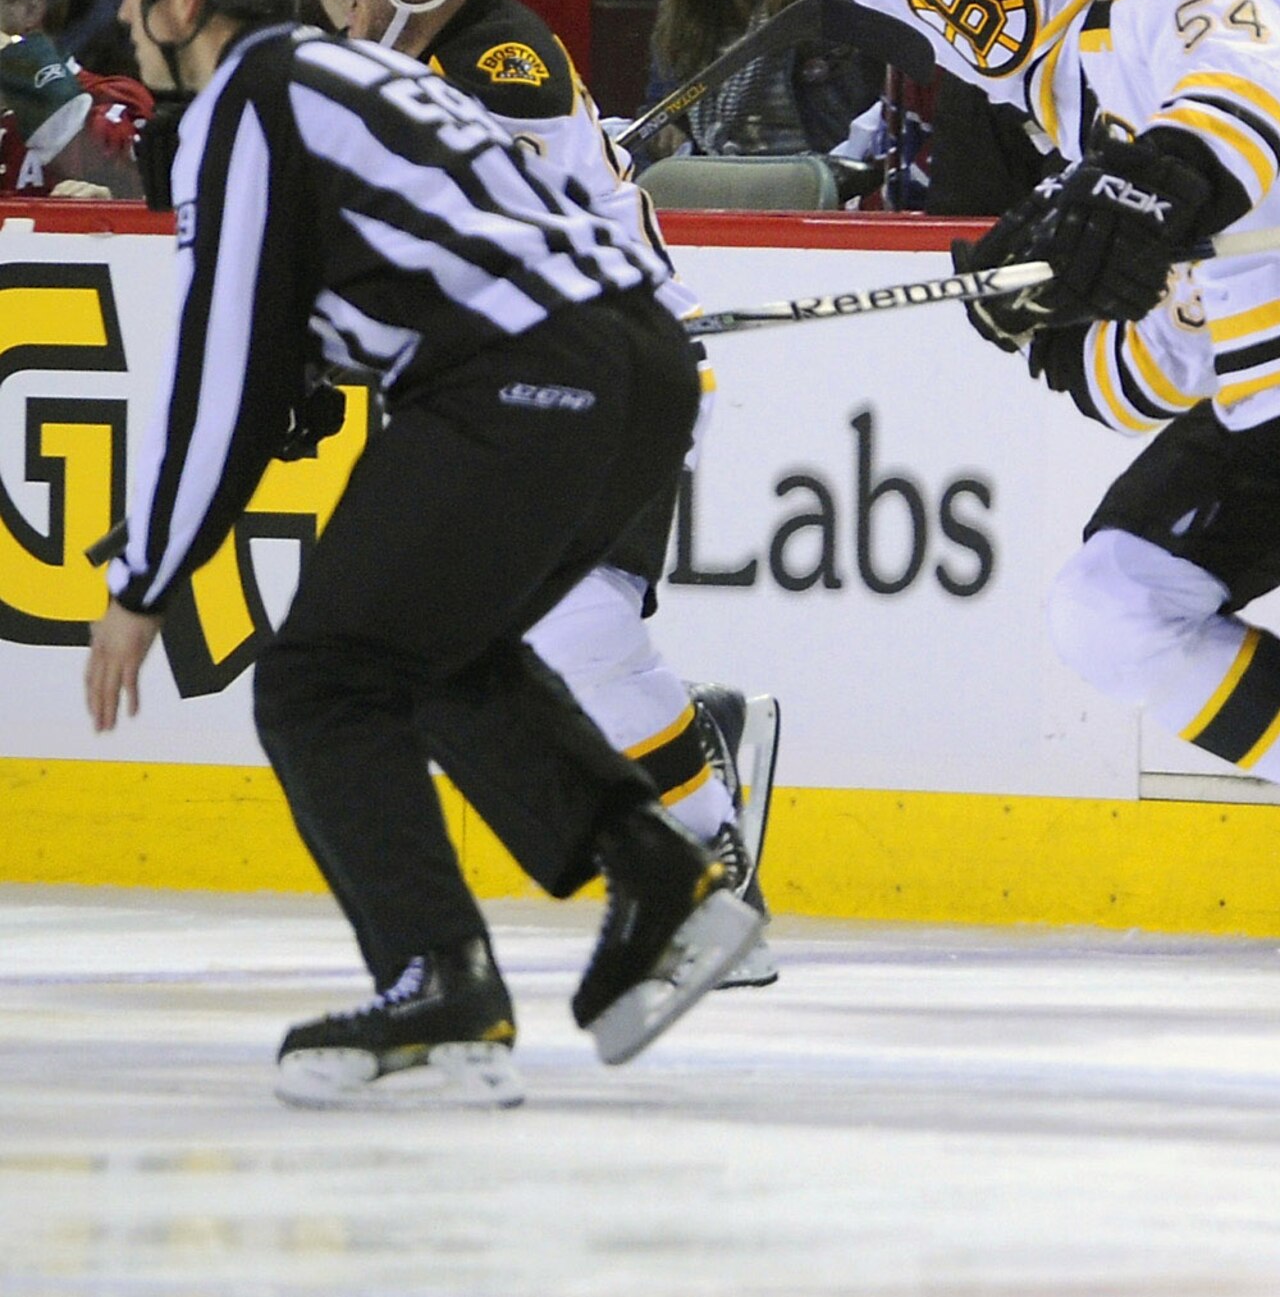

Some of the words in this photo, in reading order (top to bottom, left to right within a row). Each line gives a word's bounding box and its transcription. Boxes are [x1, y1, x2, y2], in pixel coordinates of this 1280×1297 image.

[483, 46, 546, 76] BOSTON
[788, 270, 1000, 322] Reebok
[668, 412, 996, 597] Labs
